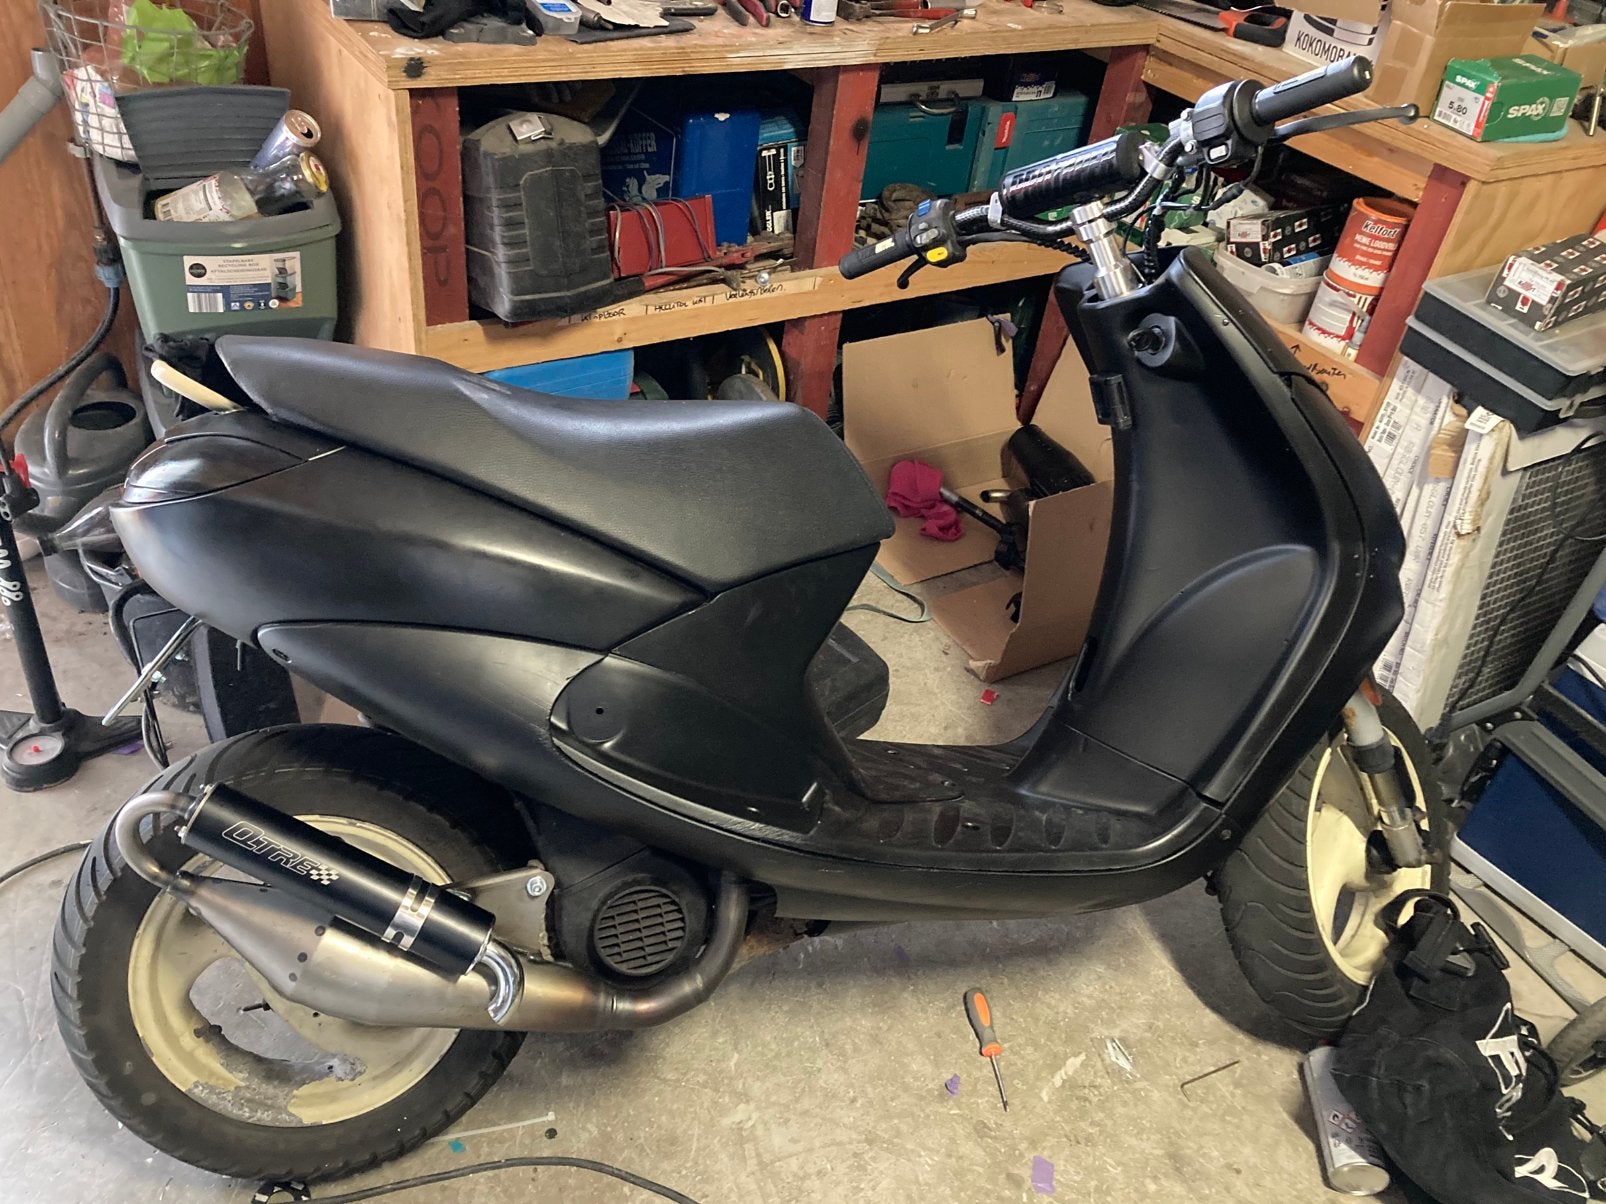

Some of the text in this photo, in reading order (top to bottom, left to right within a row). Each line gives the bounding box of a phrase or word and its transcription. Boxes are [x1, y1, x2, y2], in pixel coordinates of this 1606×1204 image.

[1455, 74, 1479, 90] SPAX
[1507, 101, 1546, 119] SPAX
[1362, 221, 1401, 238] Kelfort
